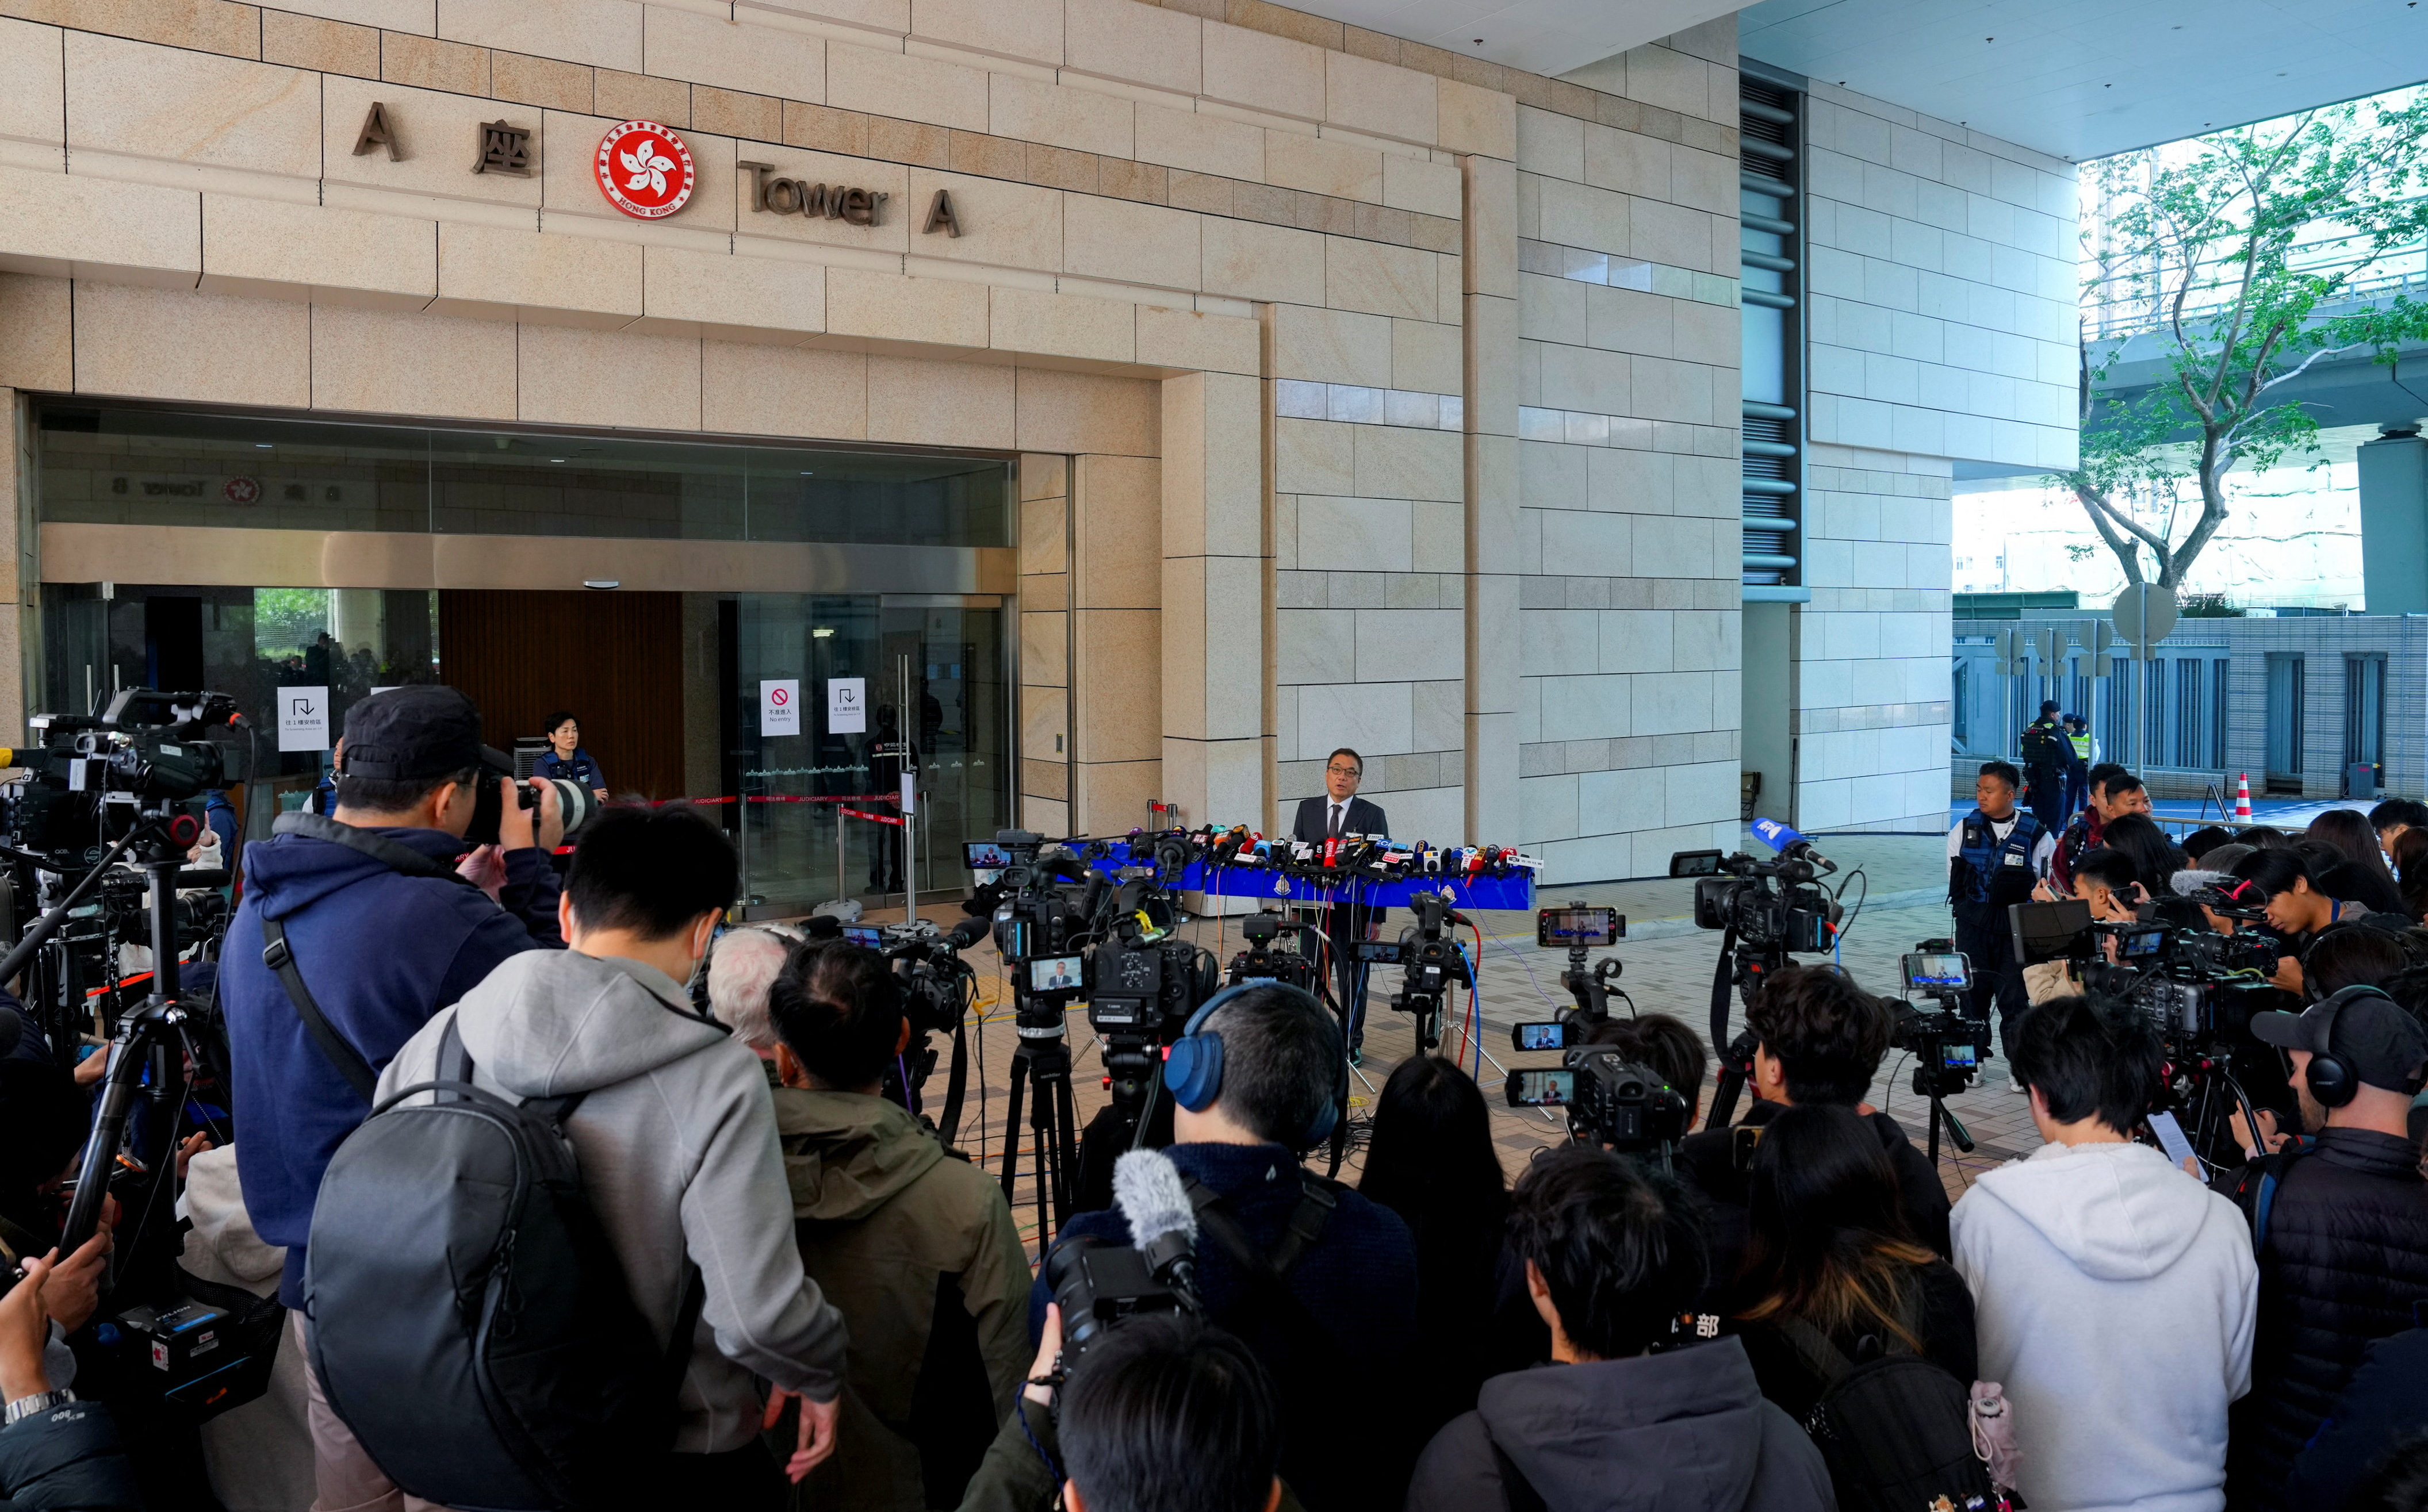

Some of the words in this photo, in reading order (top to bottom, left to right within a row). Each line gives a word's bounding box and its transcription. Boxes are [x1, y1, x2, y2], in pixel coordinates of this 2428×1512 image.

[352, 101, 400, 162] A
[470, 119, 531, 178] 座
[618, 197, 646, 215] HONG
[650, 204, 676, 216] KONG
[737, 160, 889, 227] Tower
[922, 189, 961, 238] A
[1757, 820, 1775, 832] AFP
[1326, 841, 1334, 858] XINHUA
[1696, 1313, 1720, 1338] 部
